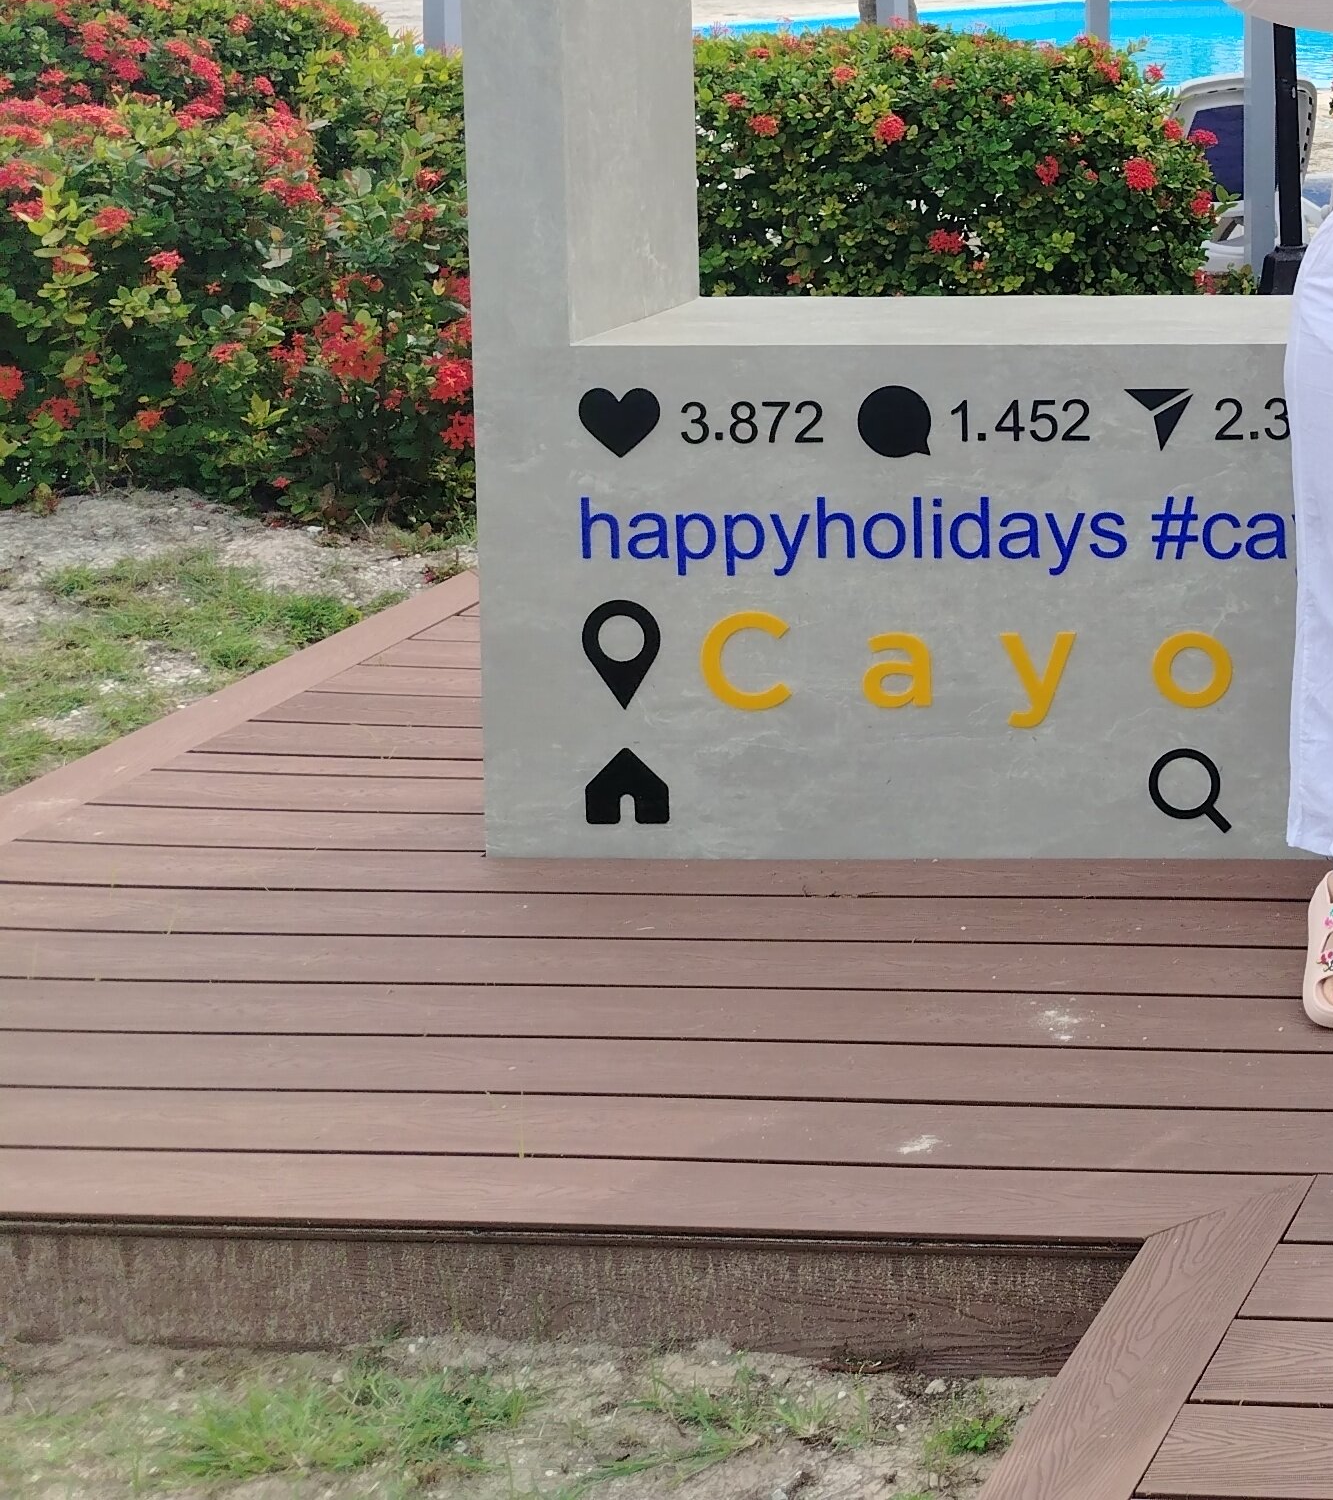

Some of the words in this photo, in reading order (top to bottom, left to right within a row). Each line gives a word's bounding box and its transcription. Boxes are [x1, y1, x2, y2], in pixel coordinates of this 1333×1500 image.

[680, 400, 824, 445] 3.872
[950, 398, 1091, 443] 1.452
[1214, 397, 1291, 441] 2.3
[579, 495, 1128, 578] happyholidays
[700, 611, 1233, 729] Cayo
